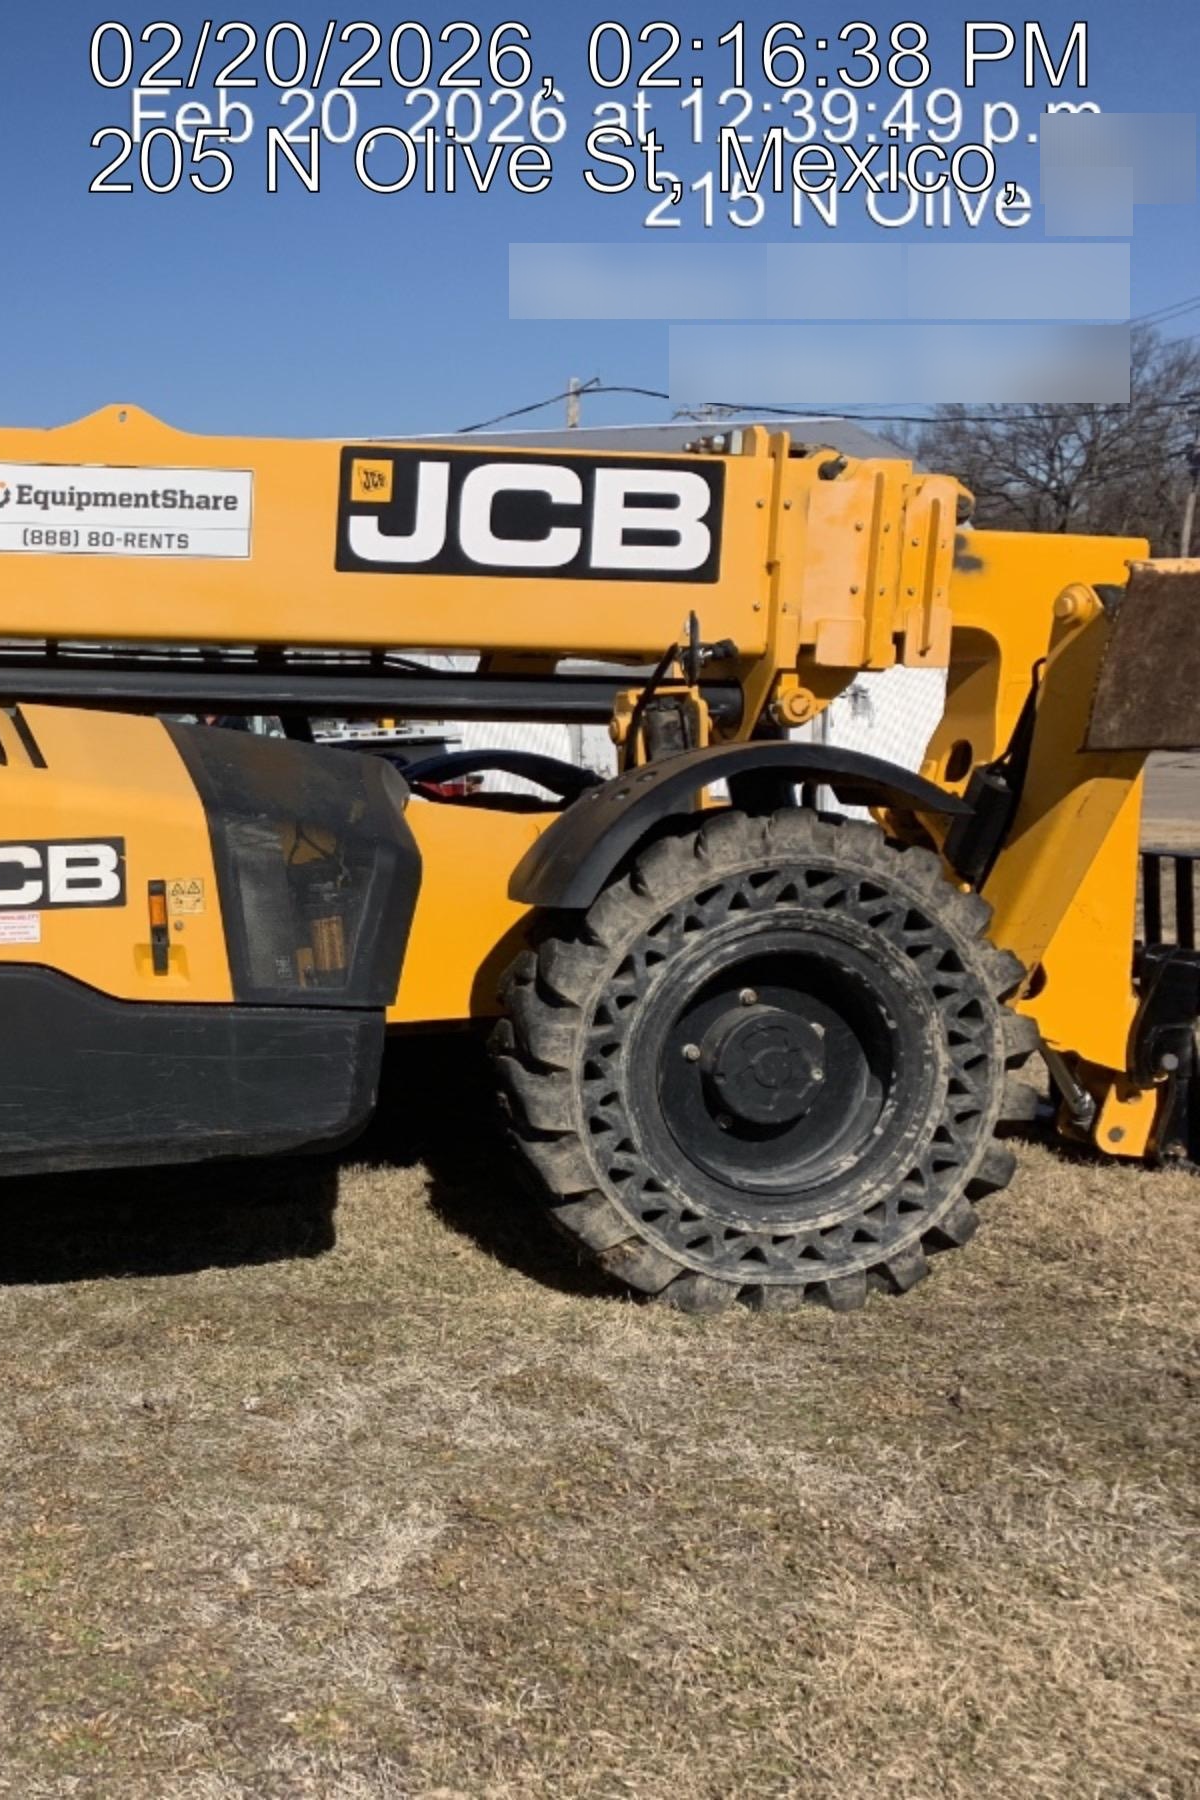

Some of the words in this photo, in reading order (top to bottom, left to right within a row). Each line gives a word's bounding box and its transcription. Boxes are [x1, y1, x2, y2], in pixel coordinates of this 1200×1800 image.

[16, 484, 238, 511] EquipmentShare
[349, 461, 711, 571] JCB
[23, 528, 80, 547] (888)
[88, 531, 189, 549] 80-RENTS
